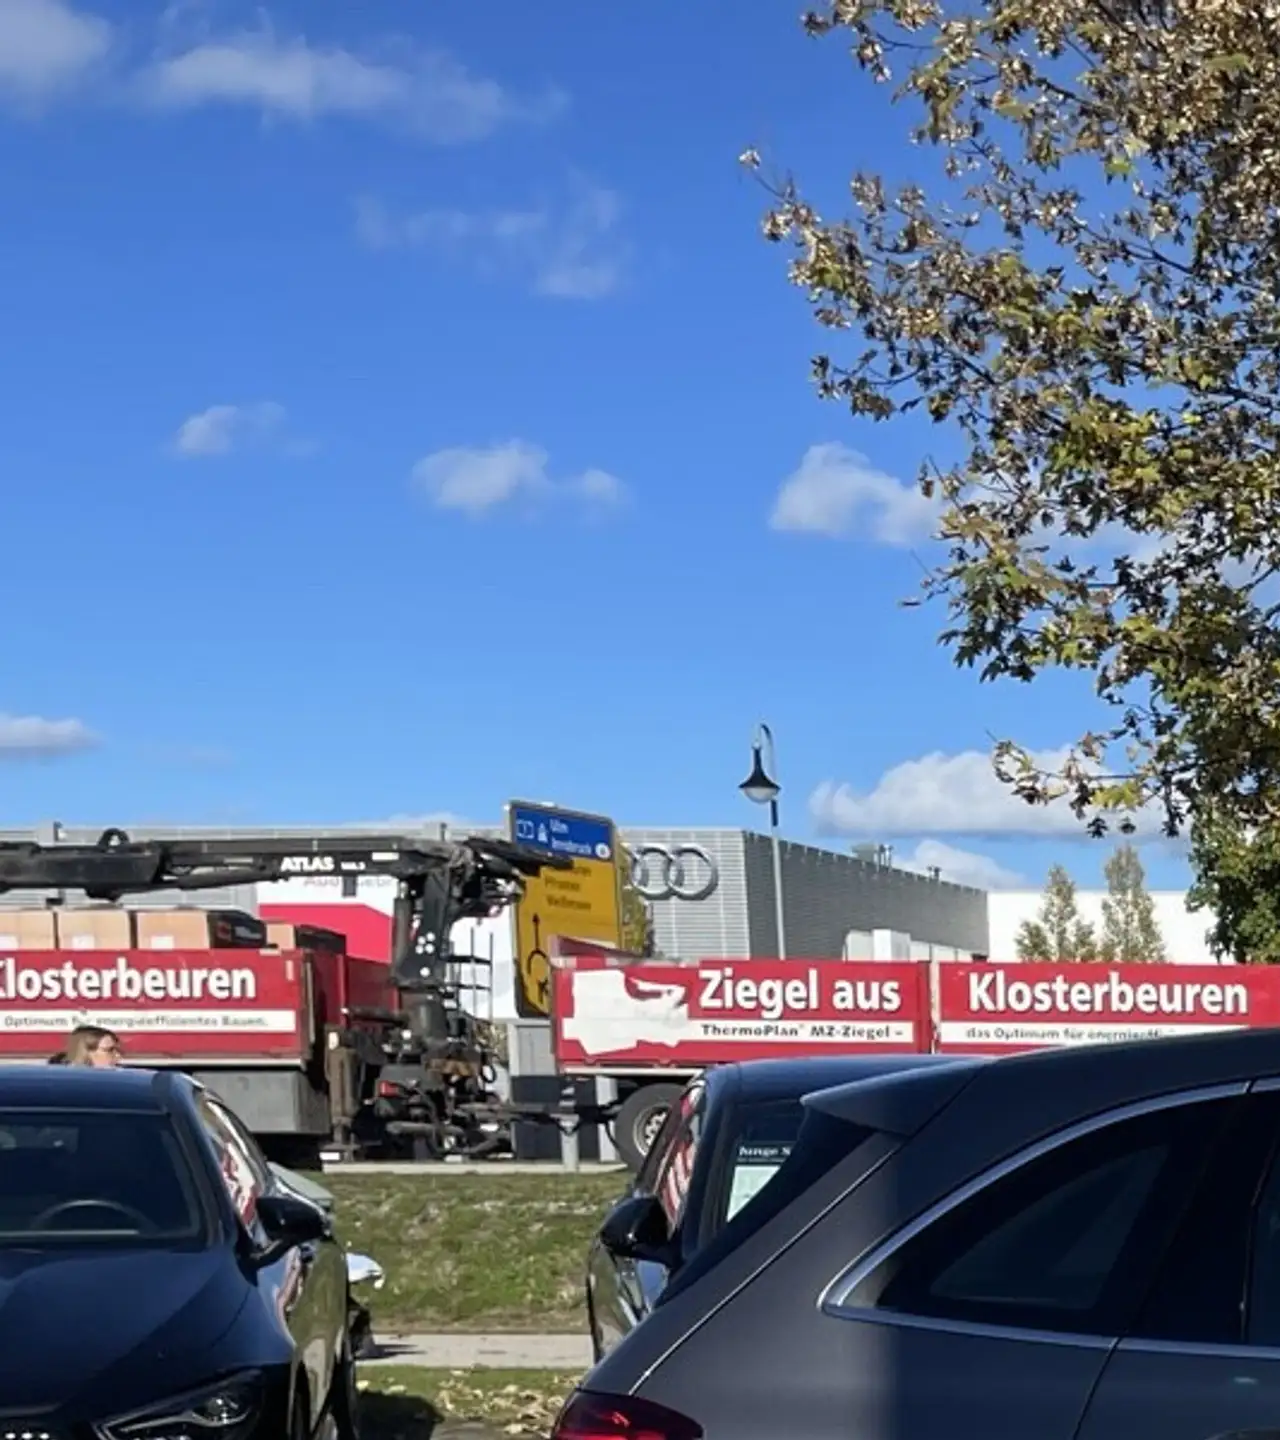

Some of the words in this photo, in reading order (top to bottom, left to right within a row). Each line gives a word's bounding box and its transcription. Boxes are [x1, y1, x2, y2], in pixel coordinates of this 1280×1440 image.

[281, 856, 335, 872] ATLAS
[0, 957, 256, 1000] losterbeuren
[698, 967, 819, 1019] Ziegel
[832, 980, 901, 1011] aus
[969, 969, 1249, 1014] Klosterbeuren
[810, 1024, 890, 1040] MZ-Ziegel
[966, 1027, 990, 1039] das
[994, 1027, 1060, 1041] Optimum
[1063, 1027, 1084, 1039] für
